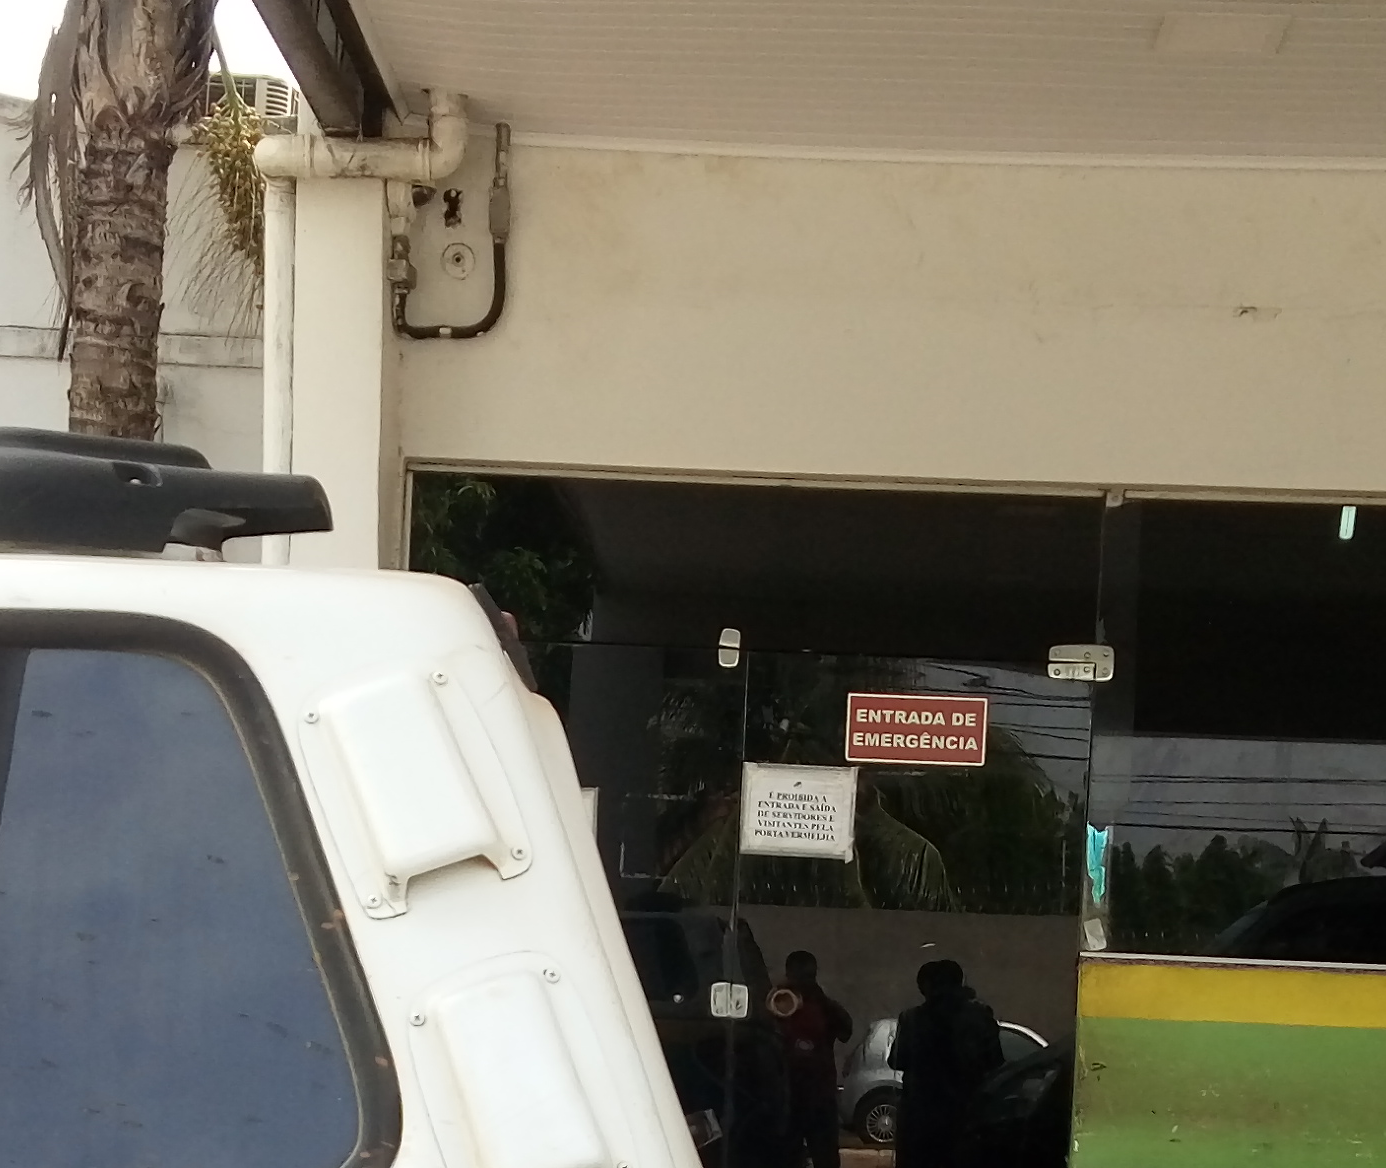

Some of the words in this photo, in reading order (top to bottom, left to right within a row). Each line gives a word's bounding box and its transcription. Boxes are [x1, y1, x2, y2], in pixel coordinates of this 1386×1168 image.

[856, 708, 946, 726] ENTRADA
[951, 712, 977, 727] DE
[852, 731, 978, 751] EMERGÊNCIA
[776, 792, 820, 803] PROIBIDA
[757, 800, 800, 811] ENTRADA
[809, 803, 837, 813] SAÍDA
[757, 810, 770, 818] DE
[772, 811, 827, 822] SERVIDORES
[757, 819, 809, 830] VISITANTES
[811, 823, 835, 832] PELA
[754, 829, 784, 838] PORTA
